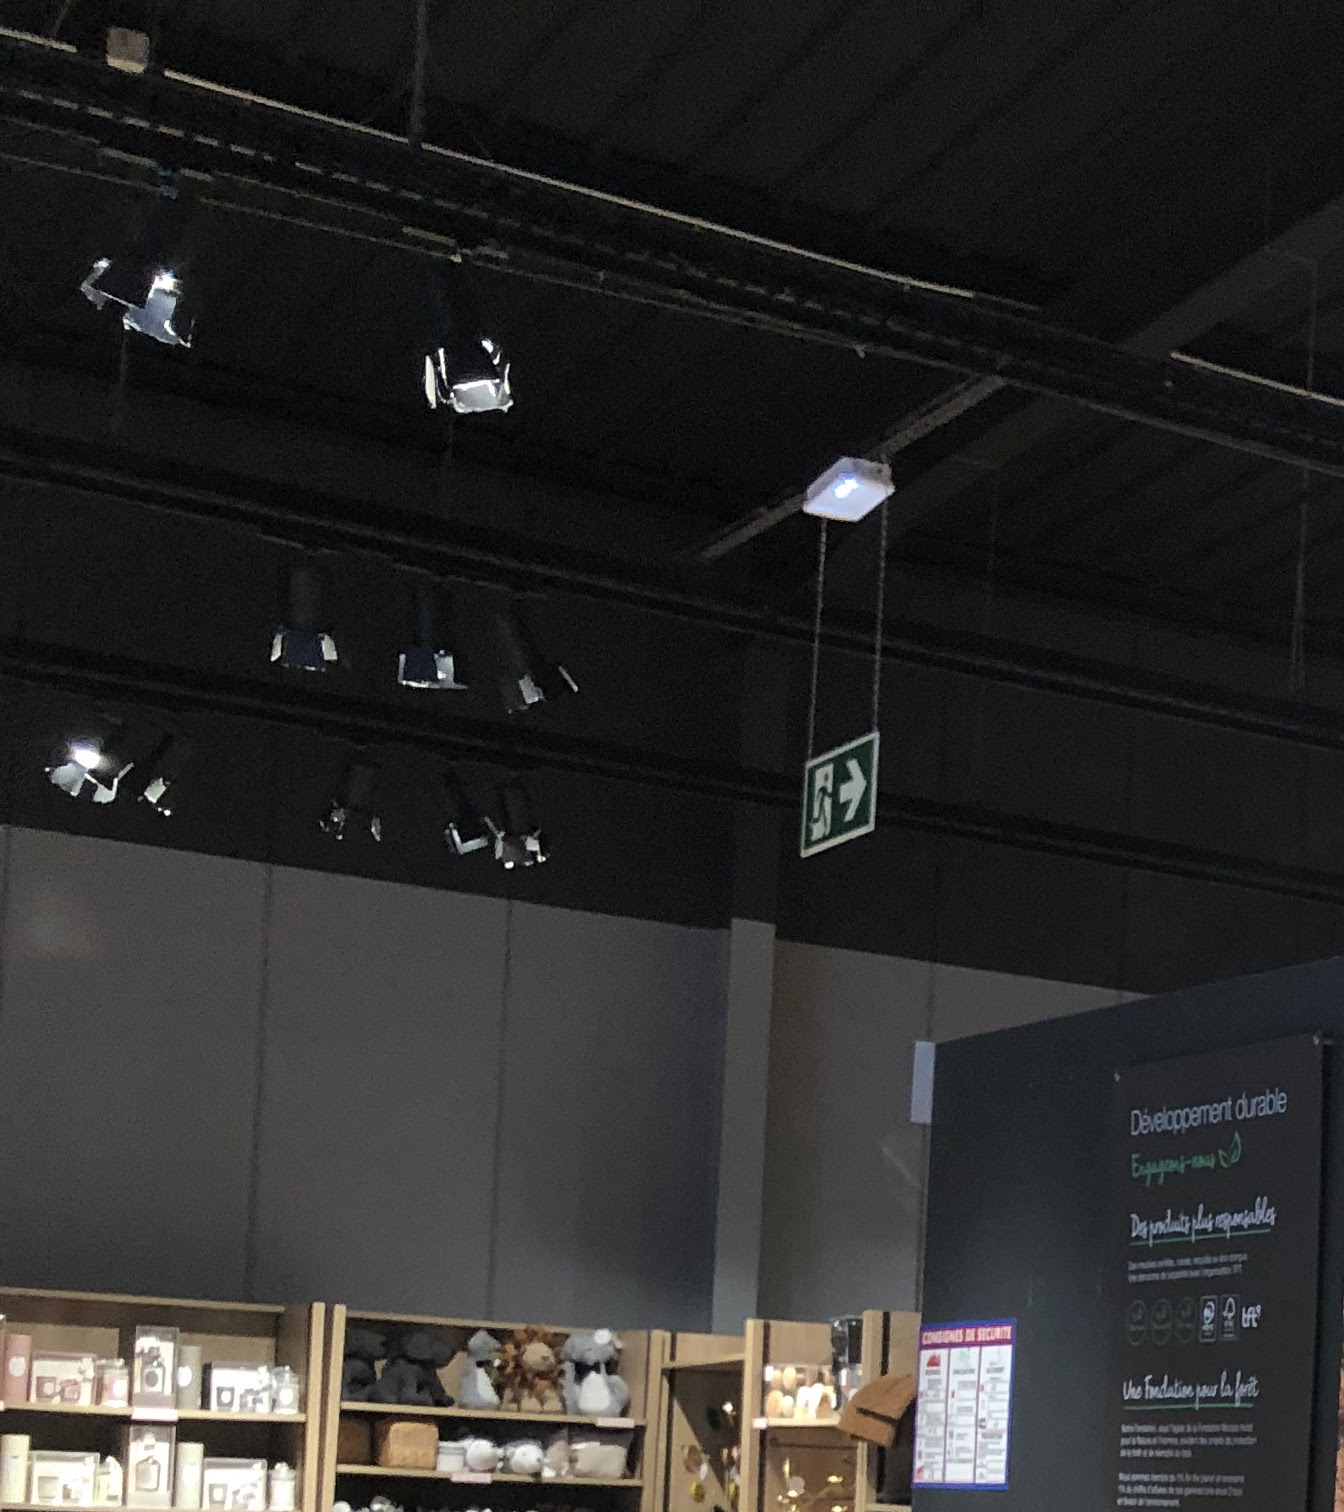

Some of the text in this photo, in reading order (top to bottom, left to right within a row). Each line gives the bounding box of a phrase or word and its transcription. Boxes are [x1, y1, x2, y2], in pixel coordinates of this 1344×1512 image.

[1130, 1087, 1287, 1136] Développement durable
[1191, 1202, 1214, 1244] plus
[1214, 1196, 1277, 1239] responsables
[1143, 1373, 1195, 1400] Fondation
[1220, 1369, 1234, 1398] la
